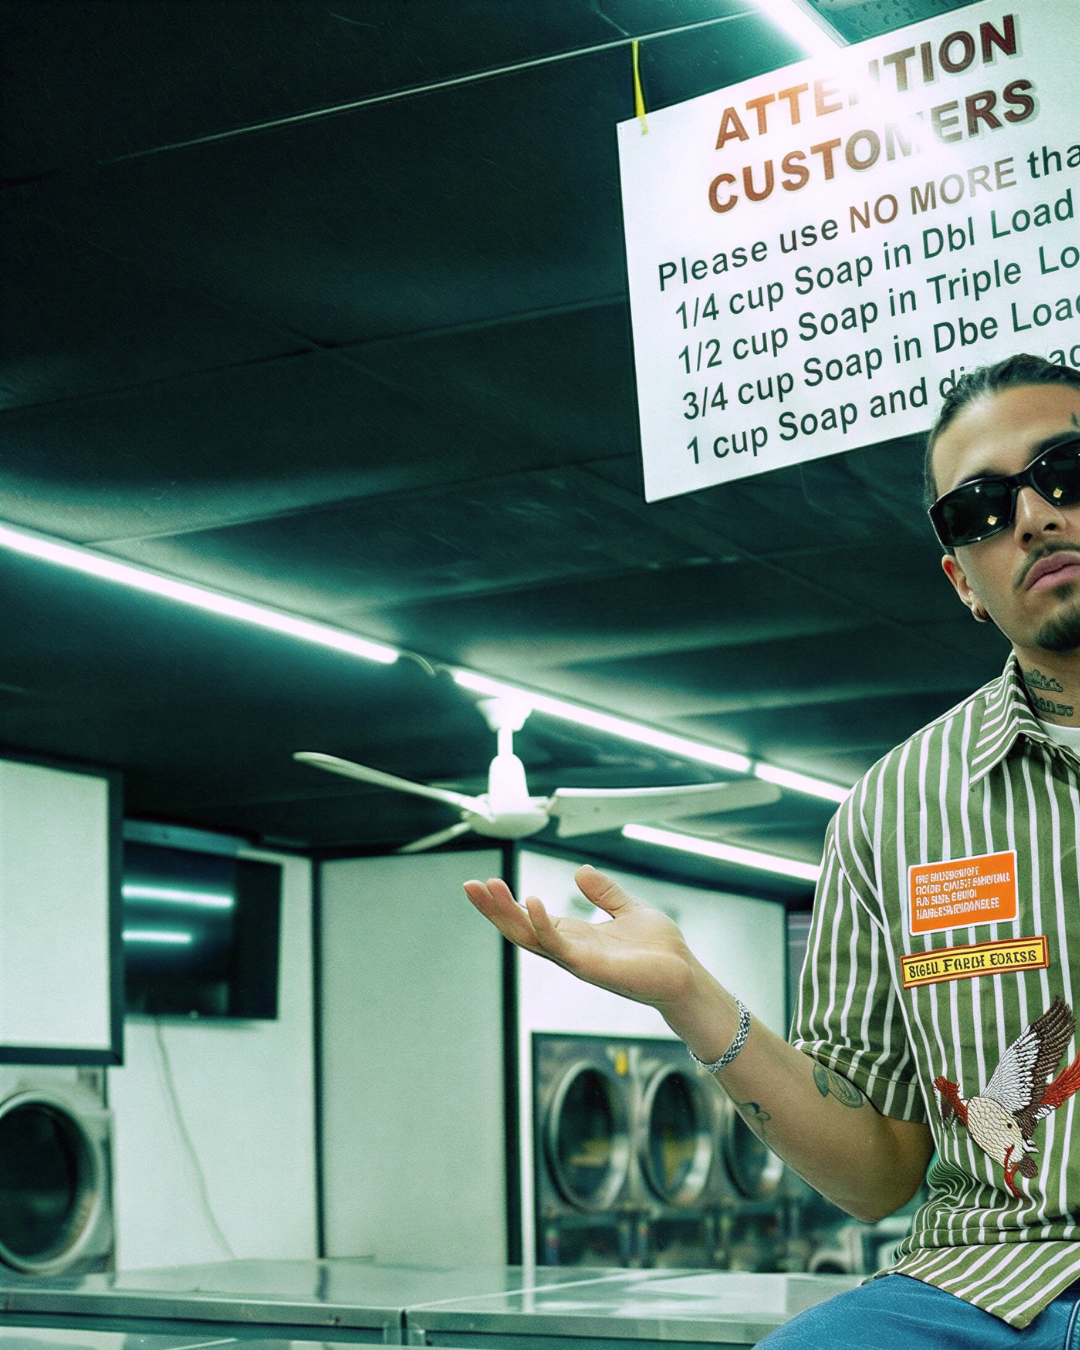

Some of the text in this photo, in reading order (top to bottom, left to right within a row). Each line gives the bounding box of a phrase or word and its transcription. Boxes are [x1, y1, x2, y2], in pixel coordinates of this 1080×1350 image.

[715, 14, 1018, 151] ATTETION
[658, 241, 768, 292] Please
[780, 219, 839, 254] use
[849, 194, 899, 234] NO
[910, 157, 1017, 215] MORE
[676, 188, 1075, 330] 1/4 cup Soap in Dbl Load
[678, 339, 722, 375] 1/2
[733, 327, 789, 360] cup
[798, 302, 878, 342] Soap
[888, 288, 917, 317] in
[926, 259, 1022, 304] Triple
[682, 382, 728, 420] 3/4
[738, 373, 794, 405] cup
[803, 348, 883, 387] Soap
[893, 335, 922, 364] in
[933, 315, 999, 354] Dbe
[687, 436, 700, 464] 1
[713, 426, 768, 458] cup
[778, 401, 858, 441] Soap
[869, 376, 928, 418] and
